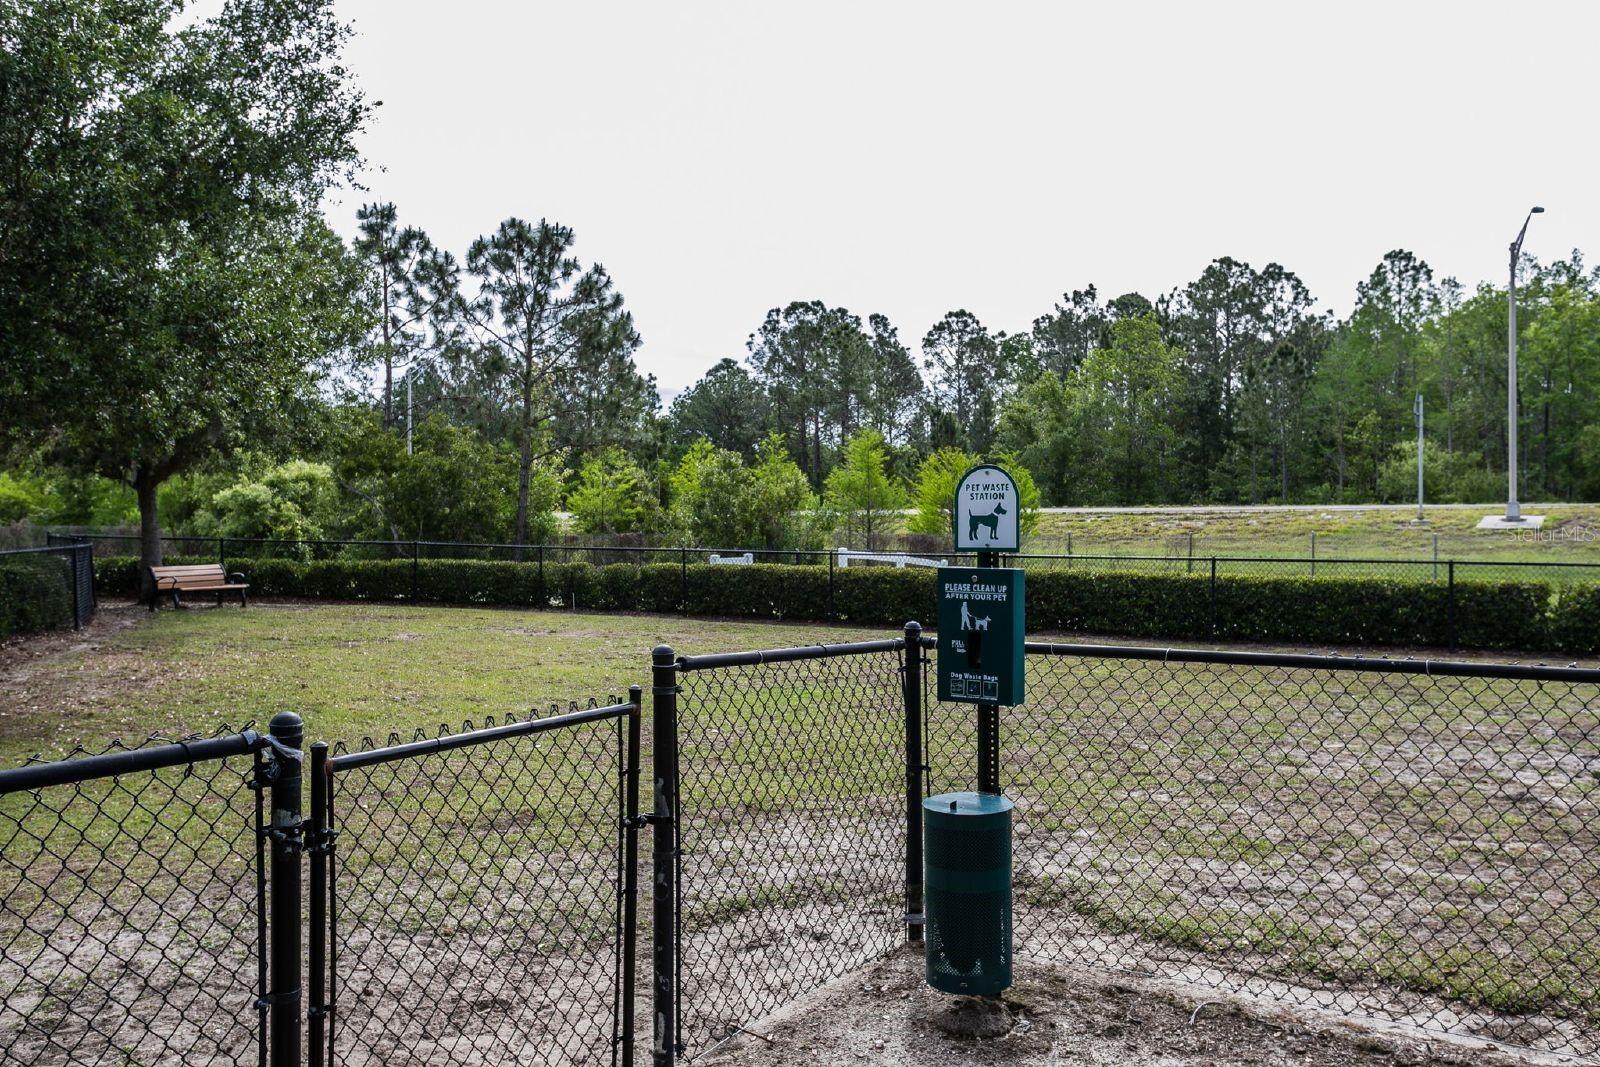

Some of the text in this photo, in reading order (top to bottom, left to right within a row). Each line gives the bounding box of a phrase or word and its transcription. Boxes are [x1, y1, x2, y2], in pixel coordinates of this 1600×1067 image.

[982, 483, 1009, 491] WASTE
[970, 492, 1005, 501] STATION
[945, 583, 1008, 593] PLEASE CLEAN UP
[970, 593, 992, 601] YOUR
[964, 672, 982, 680] Waste
